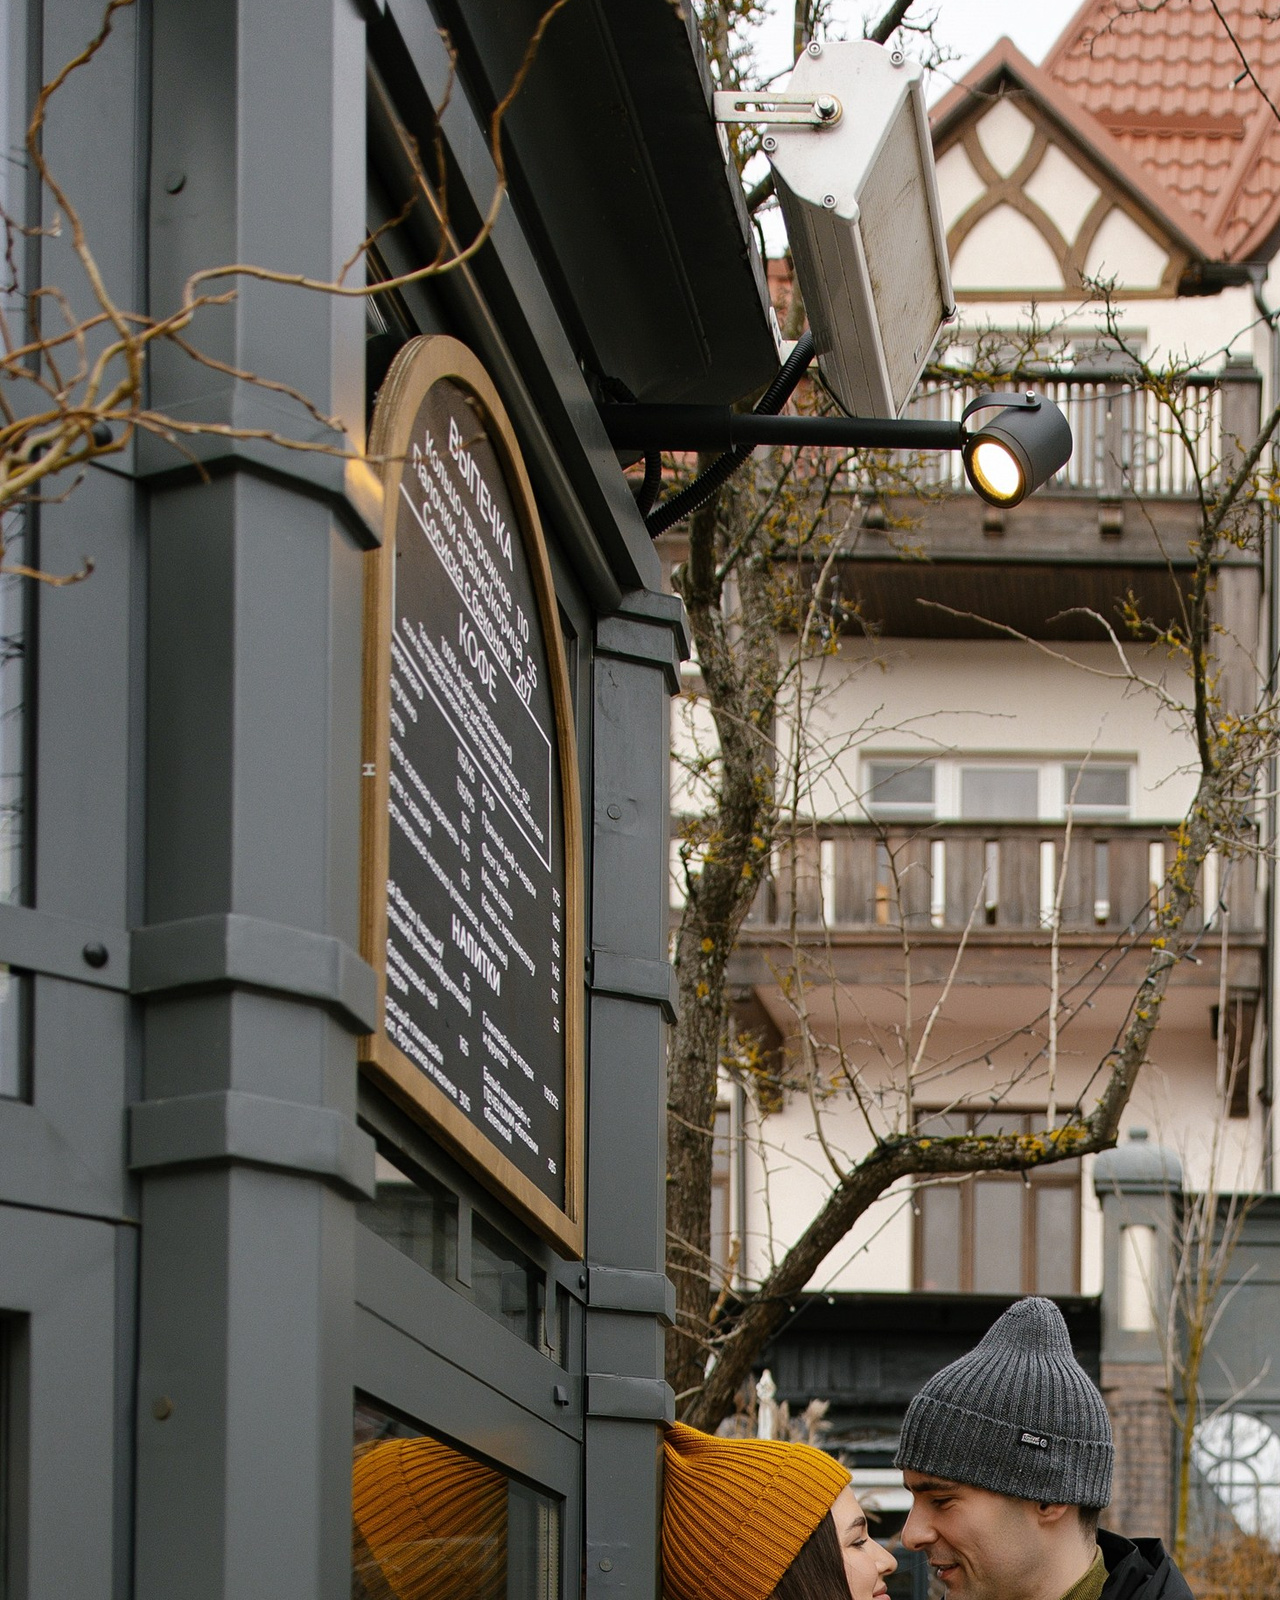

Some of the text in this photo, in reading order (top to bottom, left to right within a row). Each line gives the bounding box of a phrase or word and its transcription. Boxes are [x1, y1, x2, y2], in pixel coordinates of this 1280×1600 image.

[426, 430, 529, 643] Кольцо творожное 110
[449, 417, 513, 571] ВЫПЕЧКА
[413, 443, 537, 688] Палочки арахис/корица 55
[423, 502, 532, 709] Сосиска с беконом 207
[441, 636, 457, 672] 100%
[459, 613, 497, 703] КОФЕ
[482, 783, 495, 811] РАФ
[452, 914, 500, 996] НАПИТКИ
